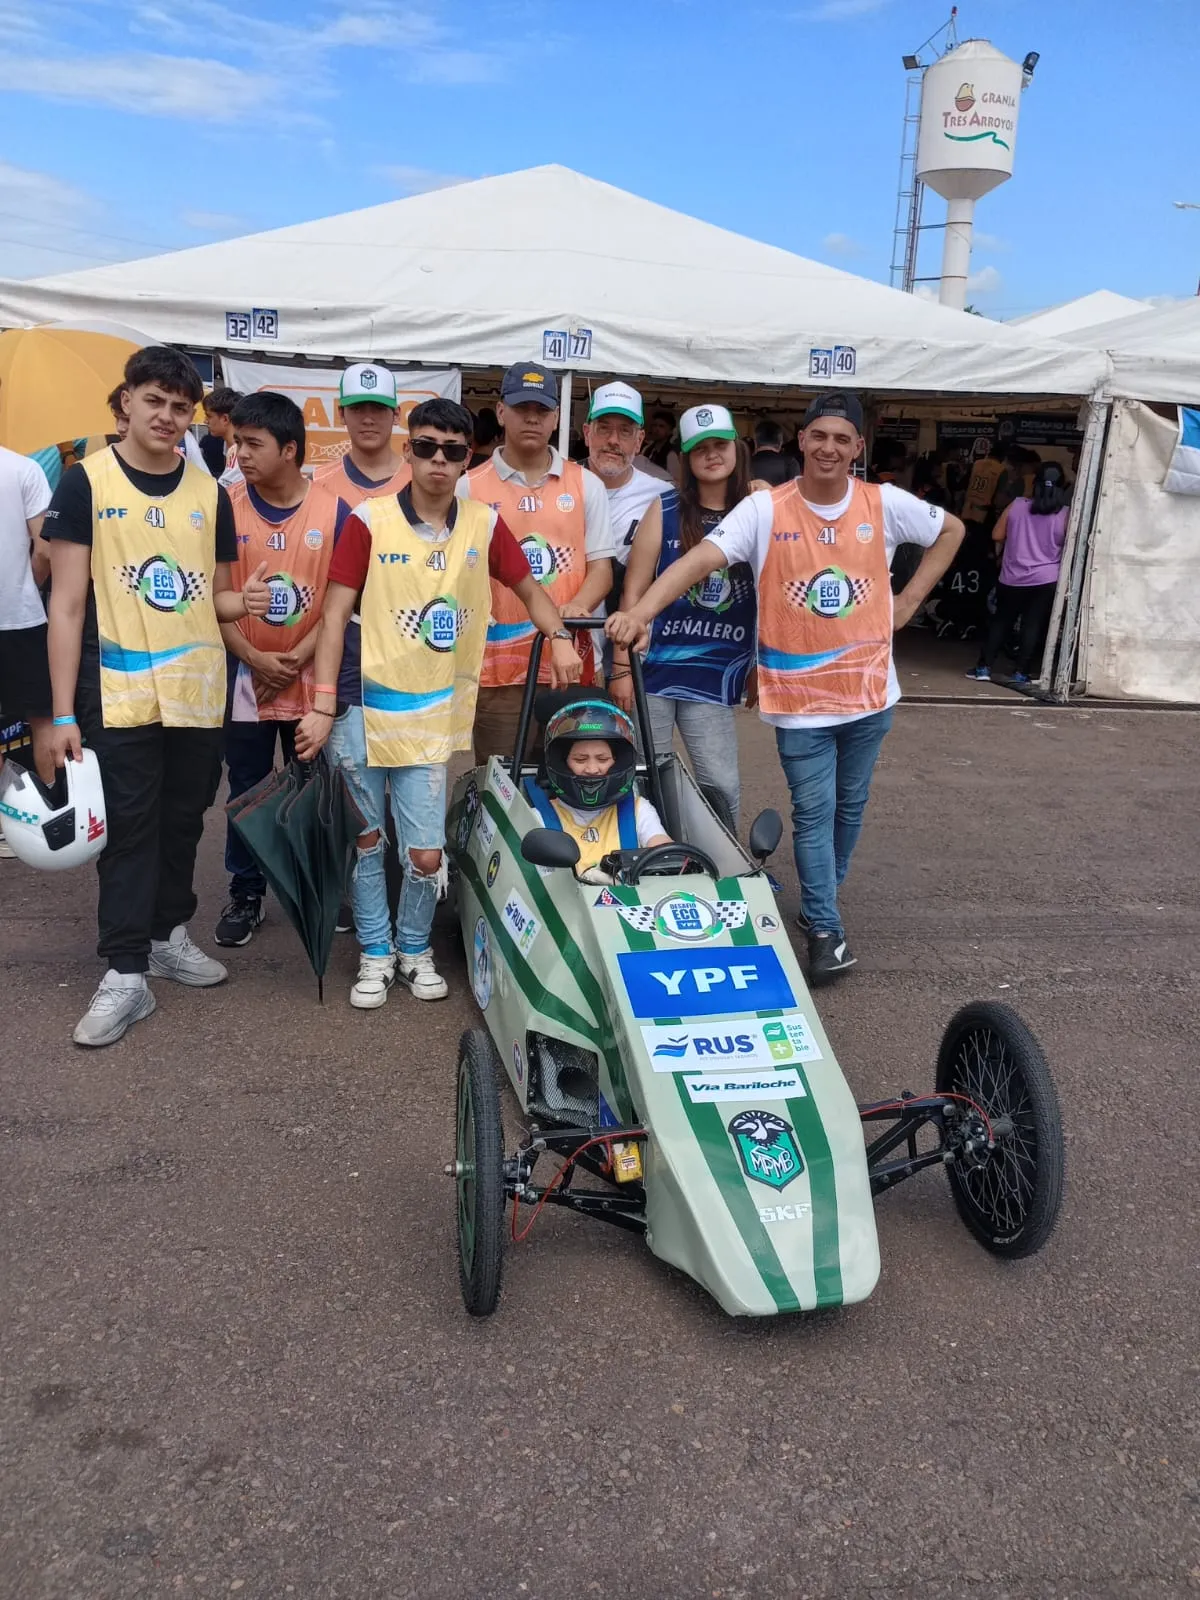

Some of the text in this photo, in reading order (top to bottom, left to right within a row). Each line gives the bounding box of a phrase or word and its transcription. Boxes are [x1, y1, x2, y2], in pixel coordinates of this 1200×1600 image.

[981, 92, 1016, 108] GRANJA
[942, 110, 1014, 131] TRES ARROYOS
[230, 318, 248, 339] 32
[257, 315, 274, 334] 42
[549, 339, 562, 358] 41
[573, 336, 587, 355] 77
[812, 356, 828, 376] 34
[836, 352, 853, 371] 40
[97, 508, 128, 520] YPF
[518, 496, 536, 513] 41
[144, 506, 166, 529] 41
[266, 531, 287, 551] 41
[772, 532, 802, 542] YPF
[816, 527, 836, 545] 41
[377, 553, 412, 564] YPF
[426, 551, 446, 571] 41
[153, 574, 175, 589] ECO
[951, 570, 980, 593] 43
[157, 591, 176, 599] YPF
[820, 586, 840, 598] ECO
[433, 617, 454, 630] ECO
[662, 616, 745, 642] SEÑALERO
[434, 632, 452, 640] YPF
[1, 721, 23, 740] YPF
[511, 908, 526, 932] RUS
[671, 909, 700, 920] ECO
[761, 916, 776, 928] A
[649, 965, 759, 996] YPF
[693, 1034, 755, 1056] RUS
[691, 1078, 797, 1092] Via Bariloche
[759, 1203, 811, 1223] SKF
